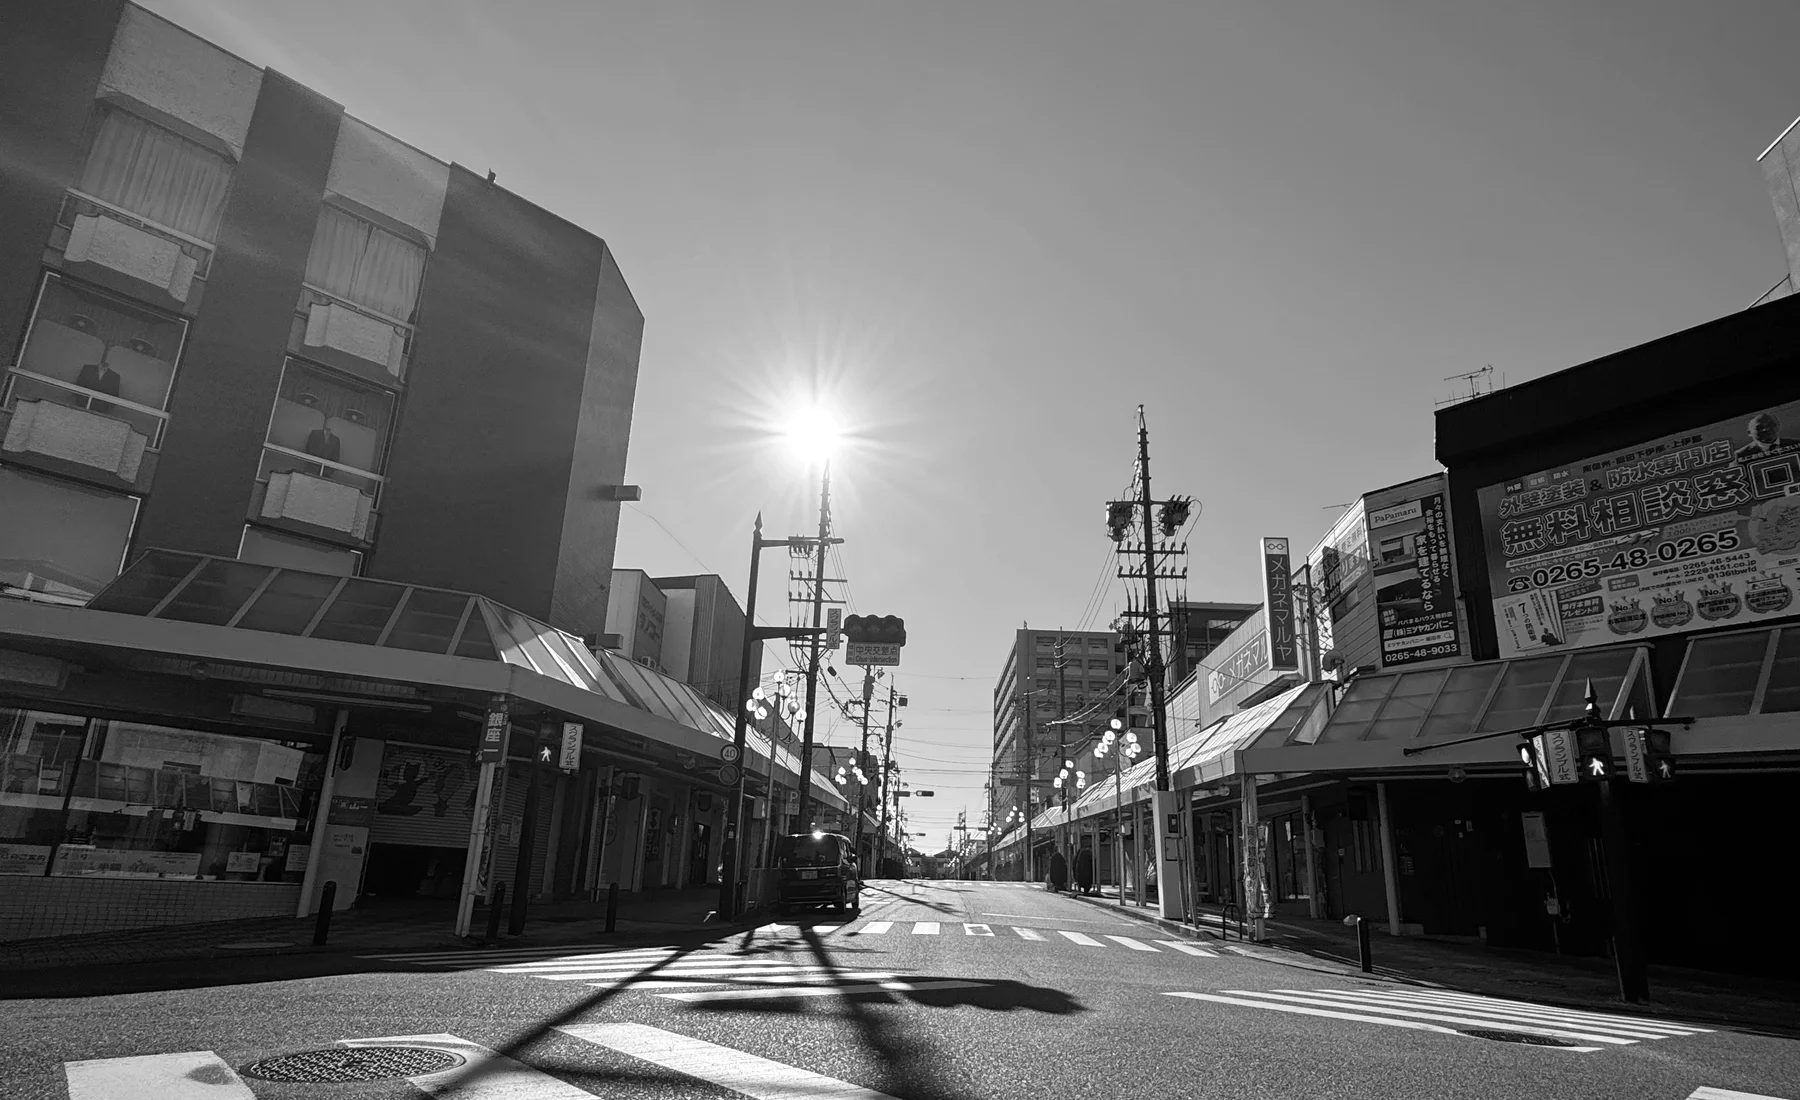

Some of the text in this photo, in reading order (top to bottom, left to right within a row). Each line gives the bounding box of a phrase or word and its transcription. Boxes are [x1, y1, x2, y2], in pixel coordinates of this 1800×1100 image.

[1500, 440, 1732, 516] 外壁塗装 & 防水専門店
[1501, 452, 1800, 556] 無料相談窓口
[1374, 508, 1417, 523] PaPamaru
[1532, 528, 1740, 587] 0265-48-0265
[1415, 534, 1434, 611] 家を建てるなら
[1659, 595, 1679, 605] No.1
[1705, 587, 1726, 597] No.1
[1271, 556, 1292, 662] メガネマルヤ
[1616, 603, 1634, 612] No.1
[856, 646, 897, 656] 中央交差点
[1385, 644, 1458, 662] 0265-48-9033
[724, 749, 735, 758] 40
[1551, 732, 1572, 781] スクランブル式
[1627, 729, 1644, 781] スクランブル式
[790, 791, 799, 803] P
